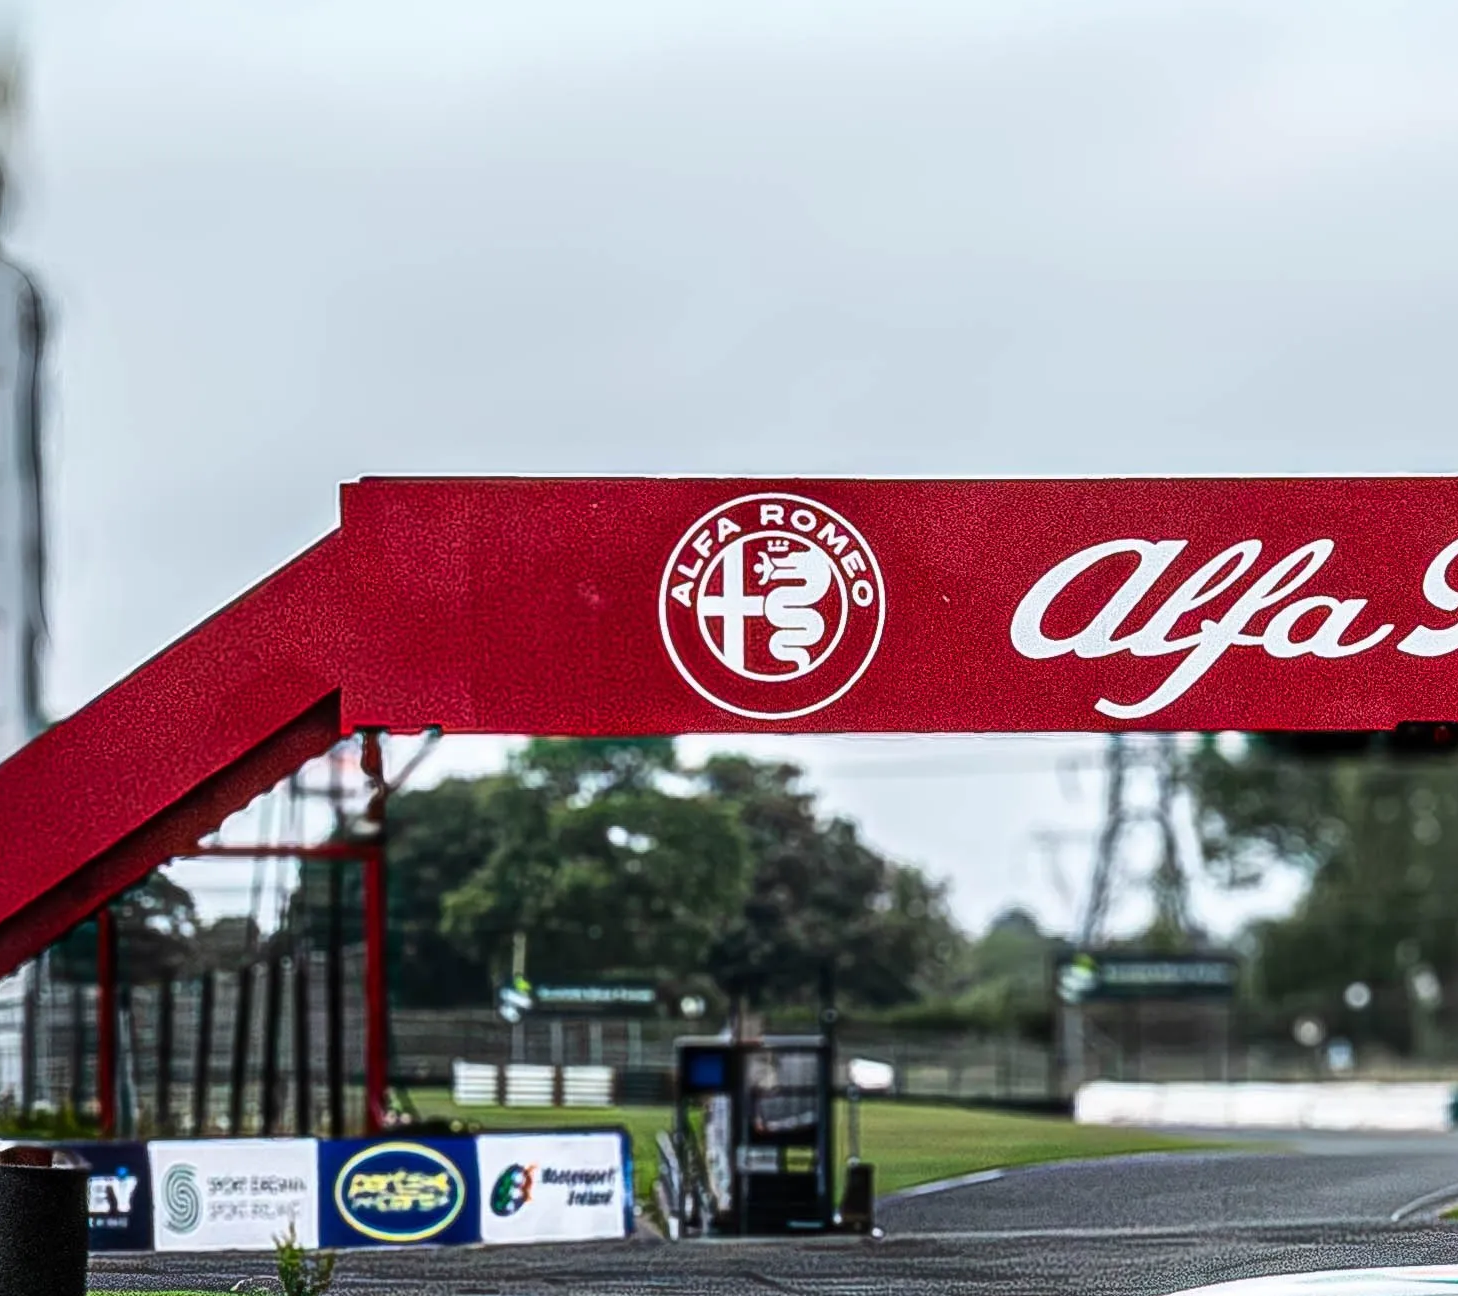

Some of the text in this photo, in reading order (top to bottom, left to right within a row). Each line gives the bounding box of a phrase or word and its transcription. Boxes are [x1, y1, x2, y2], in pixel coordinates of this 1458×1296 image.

[670, 503, 874, 608] ALFA ROMEO
[1009, 537, 1395, 719] Alfa
